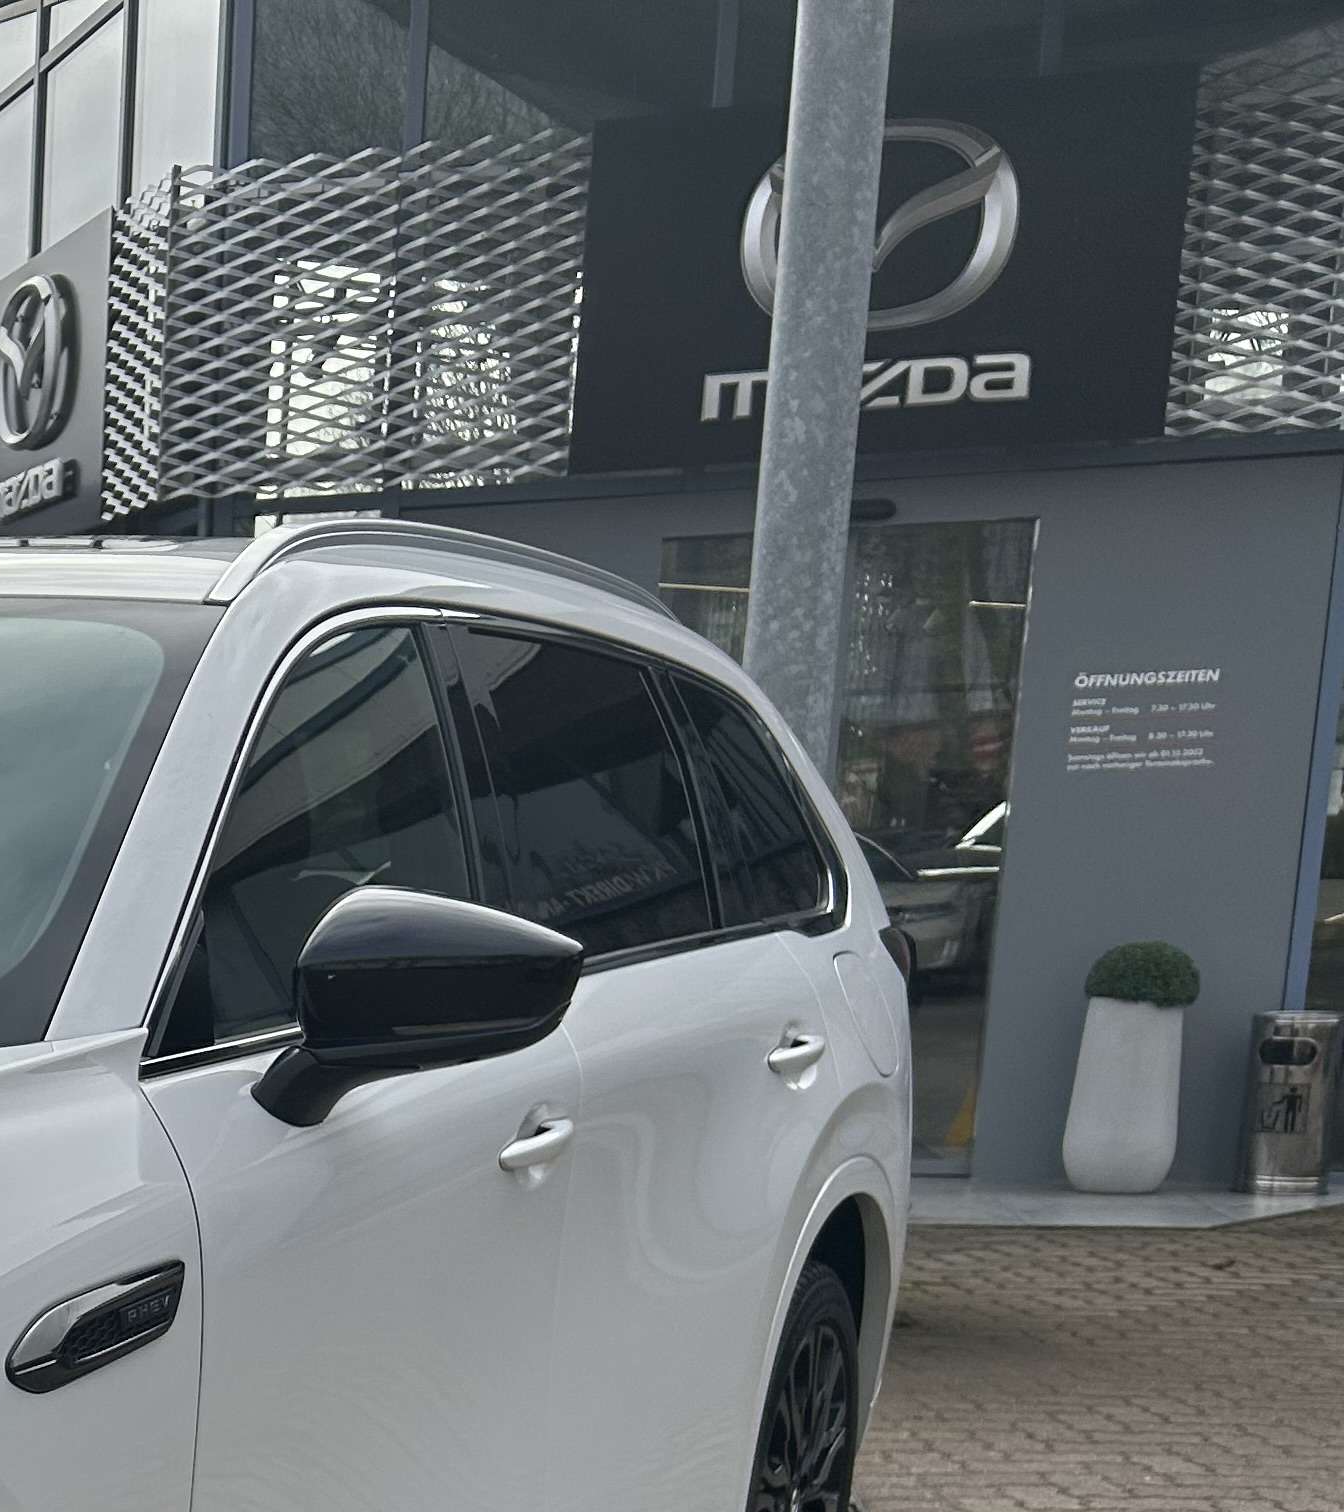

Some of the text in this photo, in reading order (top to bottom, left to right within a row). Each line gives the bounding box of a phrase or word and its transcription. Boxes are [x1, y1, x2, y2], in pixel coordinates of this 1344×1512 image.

[701, 353, 1031, 422] mzda
[1074, 668, 1221, 689] ÖFFNUNGSZEITEN
[127, 1295, 170, 1322] PHEV
